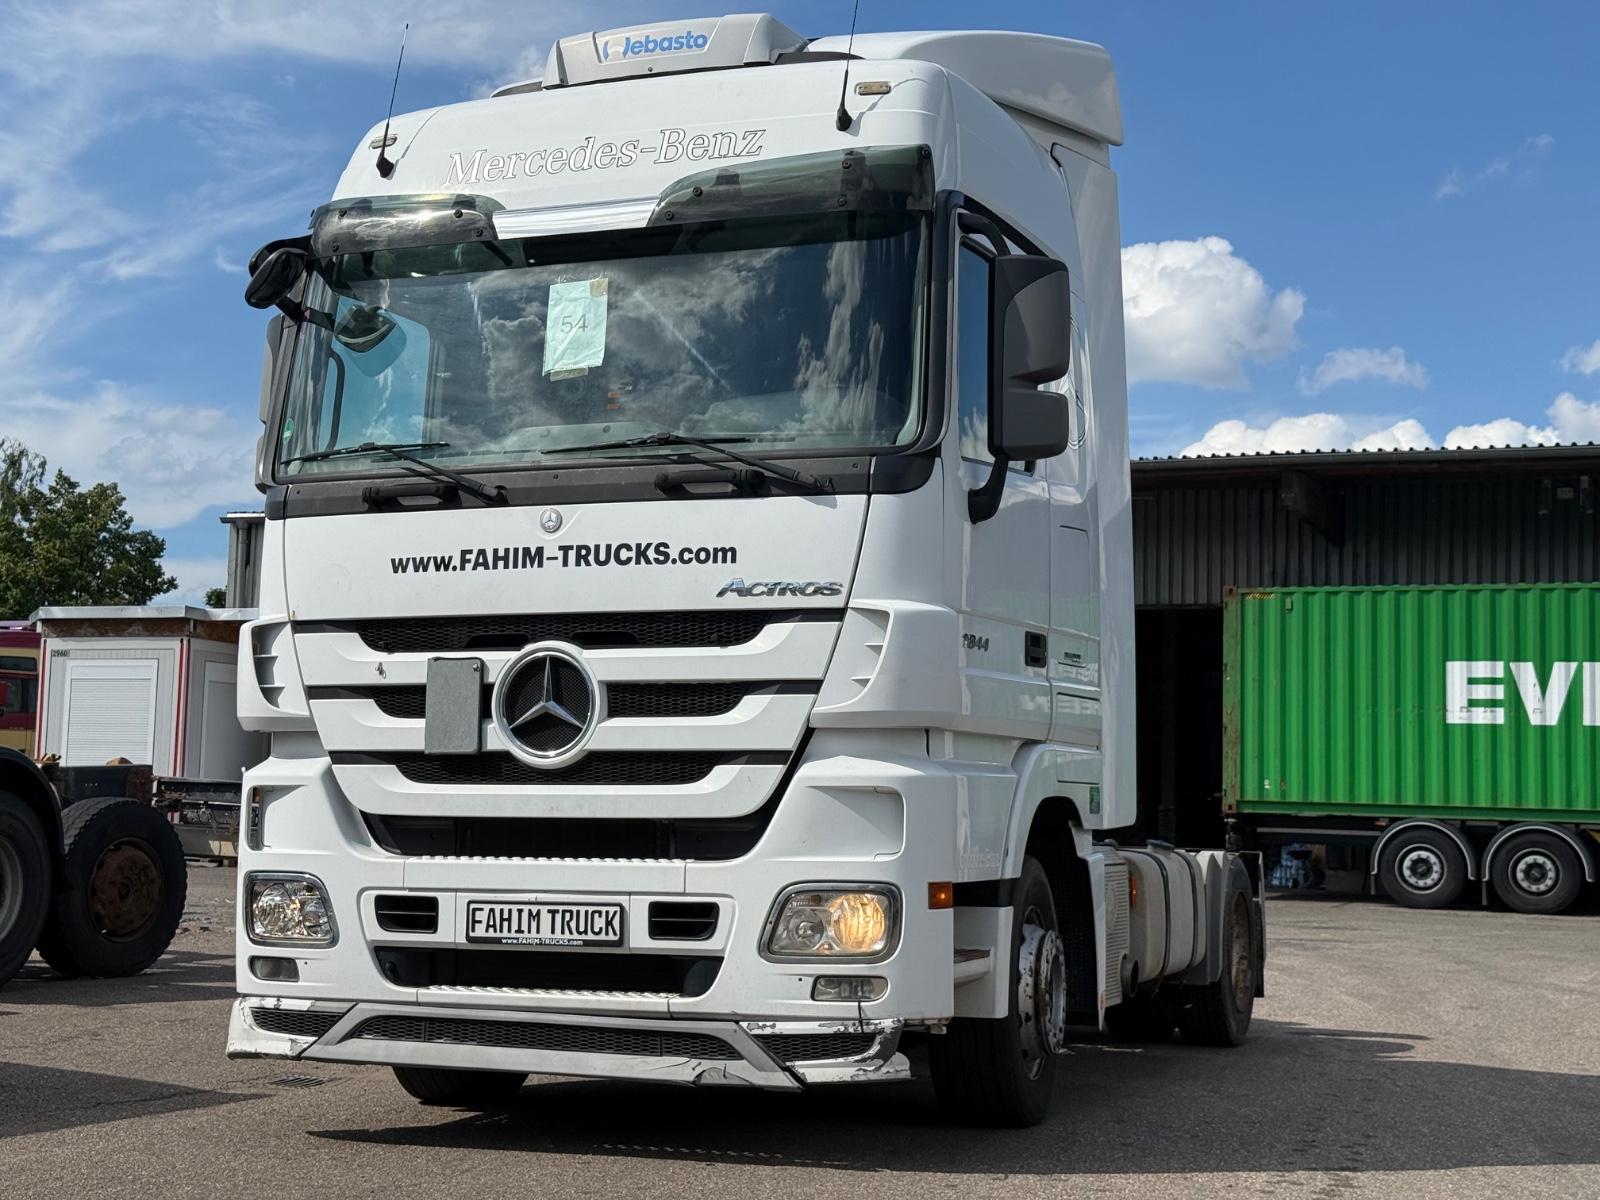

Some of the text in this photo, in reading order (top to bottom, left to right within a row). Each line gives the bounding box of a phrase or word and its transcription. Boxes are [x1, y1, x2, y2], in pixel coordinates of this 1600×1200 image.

[442, 127, 767, 188] Mercedes-Benz
[560, 313, 588, 334] 54
[390, 541, 738, 574] www.FAHIM-TRUCKS.com
[1445, 660, 1600, 726] EV
[470, 907, 619, 937] FAHIM TRUCK
